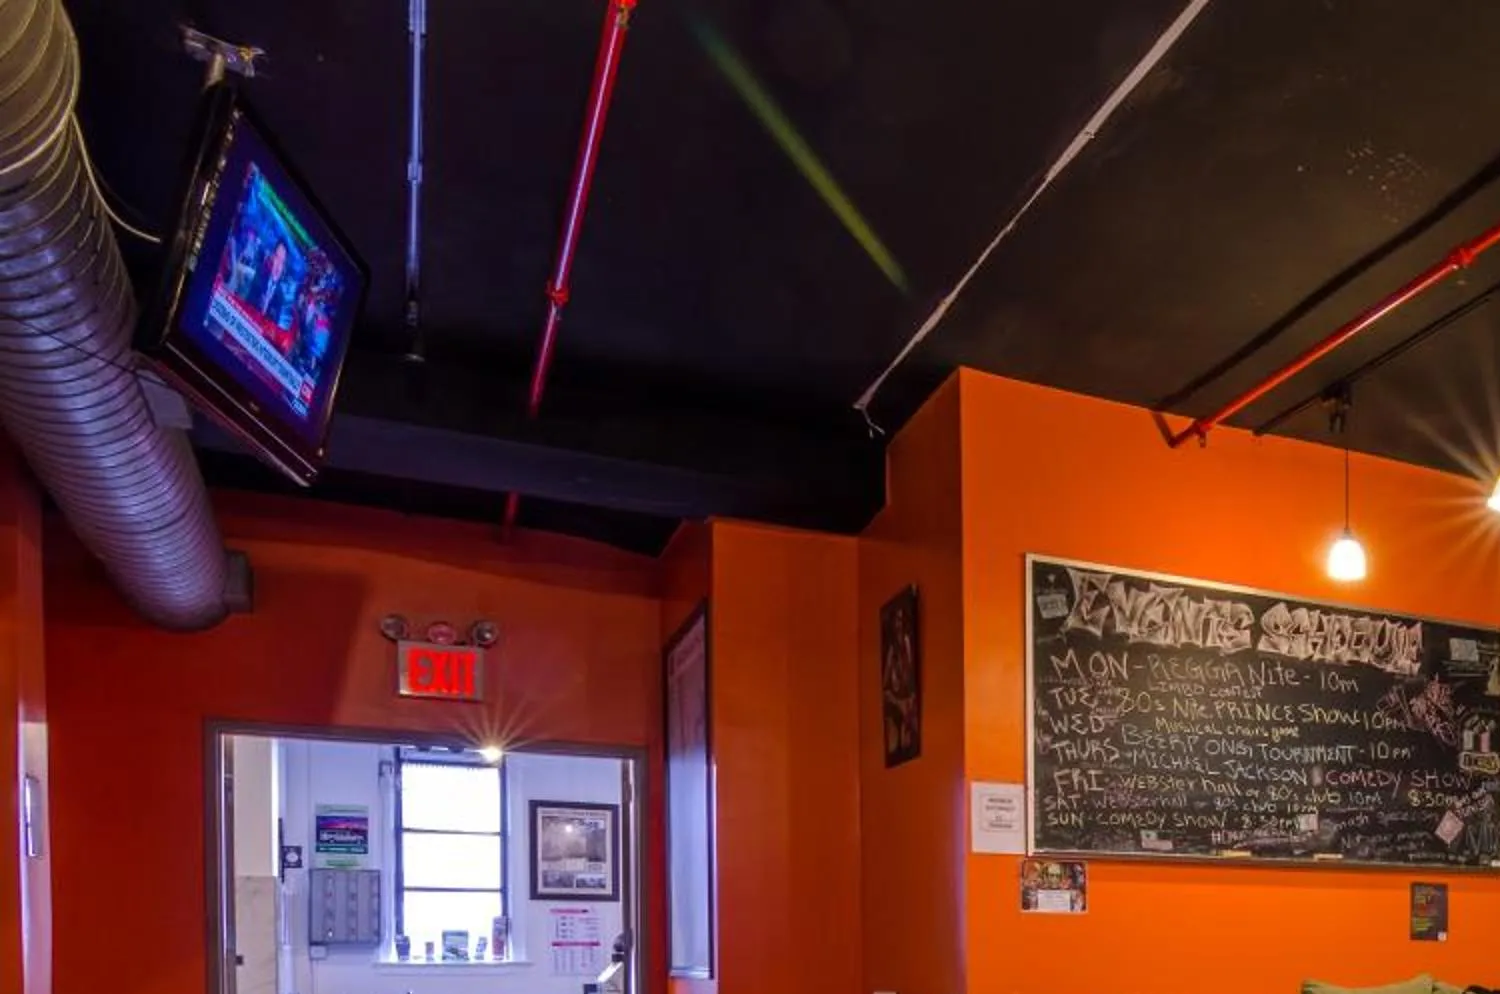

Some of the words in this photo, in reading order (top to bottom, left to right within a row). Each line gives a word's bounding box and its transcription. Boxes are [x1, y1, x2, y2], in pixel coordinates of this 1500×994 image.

[407, 646, 478, 698] EXIT
[1050, 649, 1128, 684] MON
[1214, 700, 1296, 723] PRINCE
[1051, 737, 1120, 764] THURS
[1053, 767, 1105, 795] FRI
[1221, 760, 1308, 786] JACKSON
